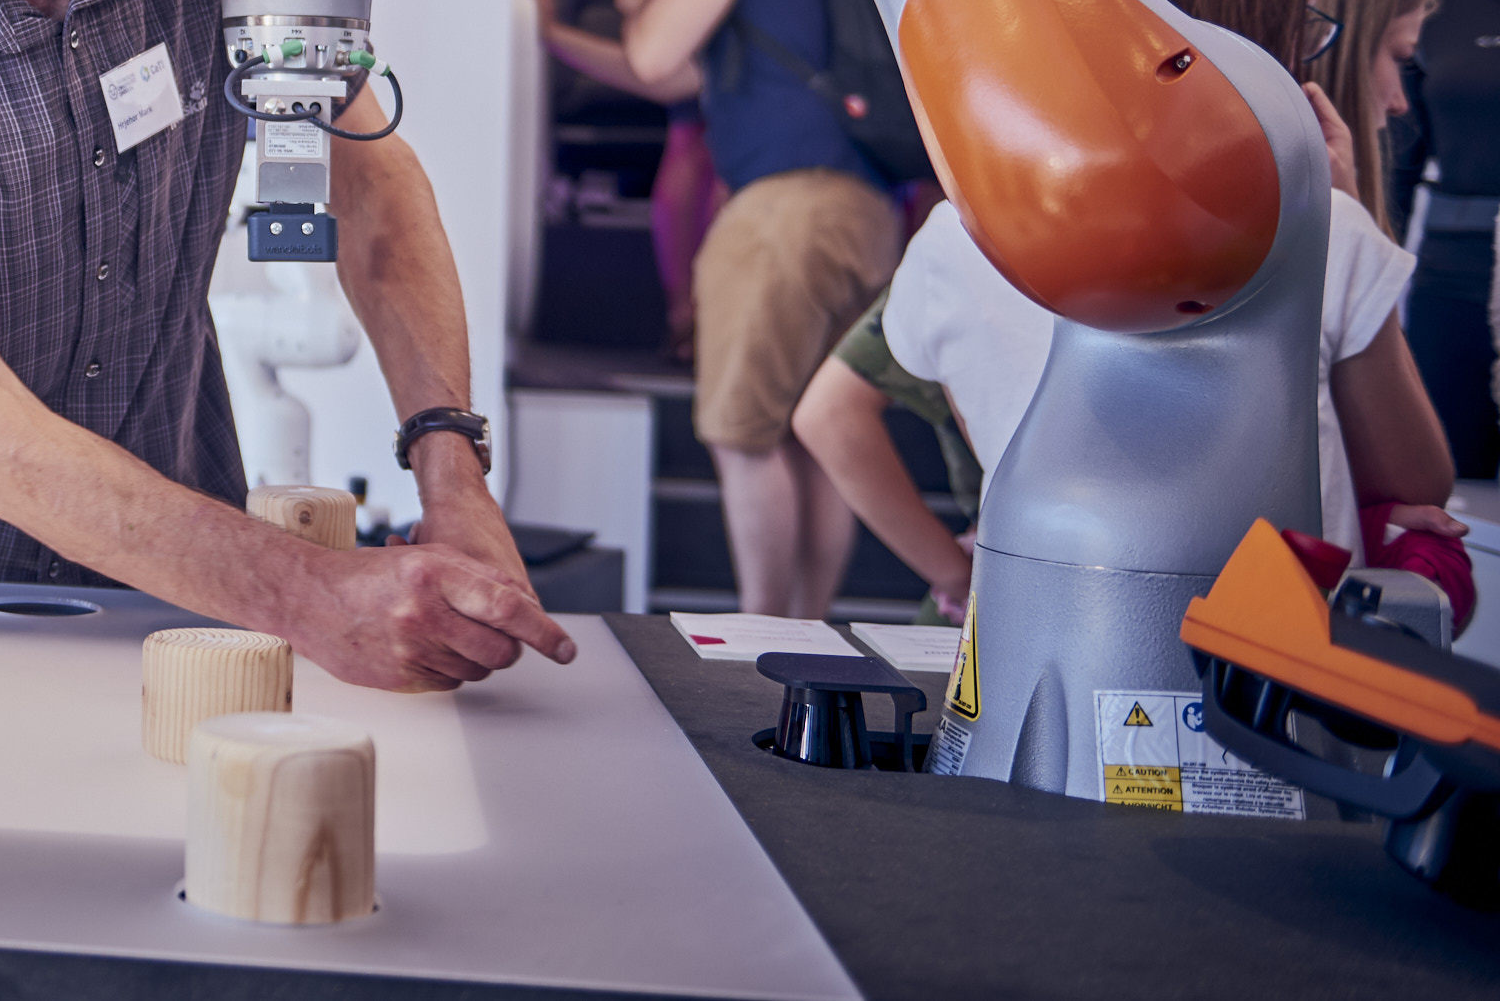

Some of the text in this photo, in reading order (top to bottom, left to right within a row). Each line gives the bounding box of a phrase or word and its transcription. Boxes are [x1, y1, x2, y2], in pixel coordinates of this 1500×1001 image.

[264, 243, 323, 255] wandelbots
[1128, 768, 1167, 777] CAUTION
[1125, 786, 1173, 795] ATTENTION
